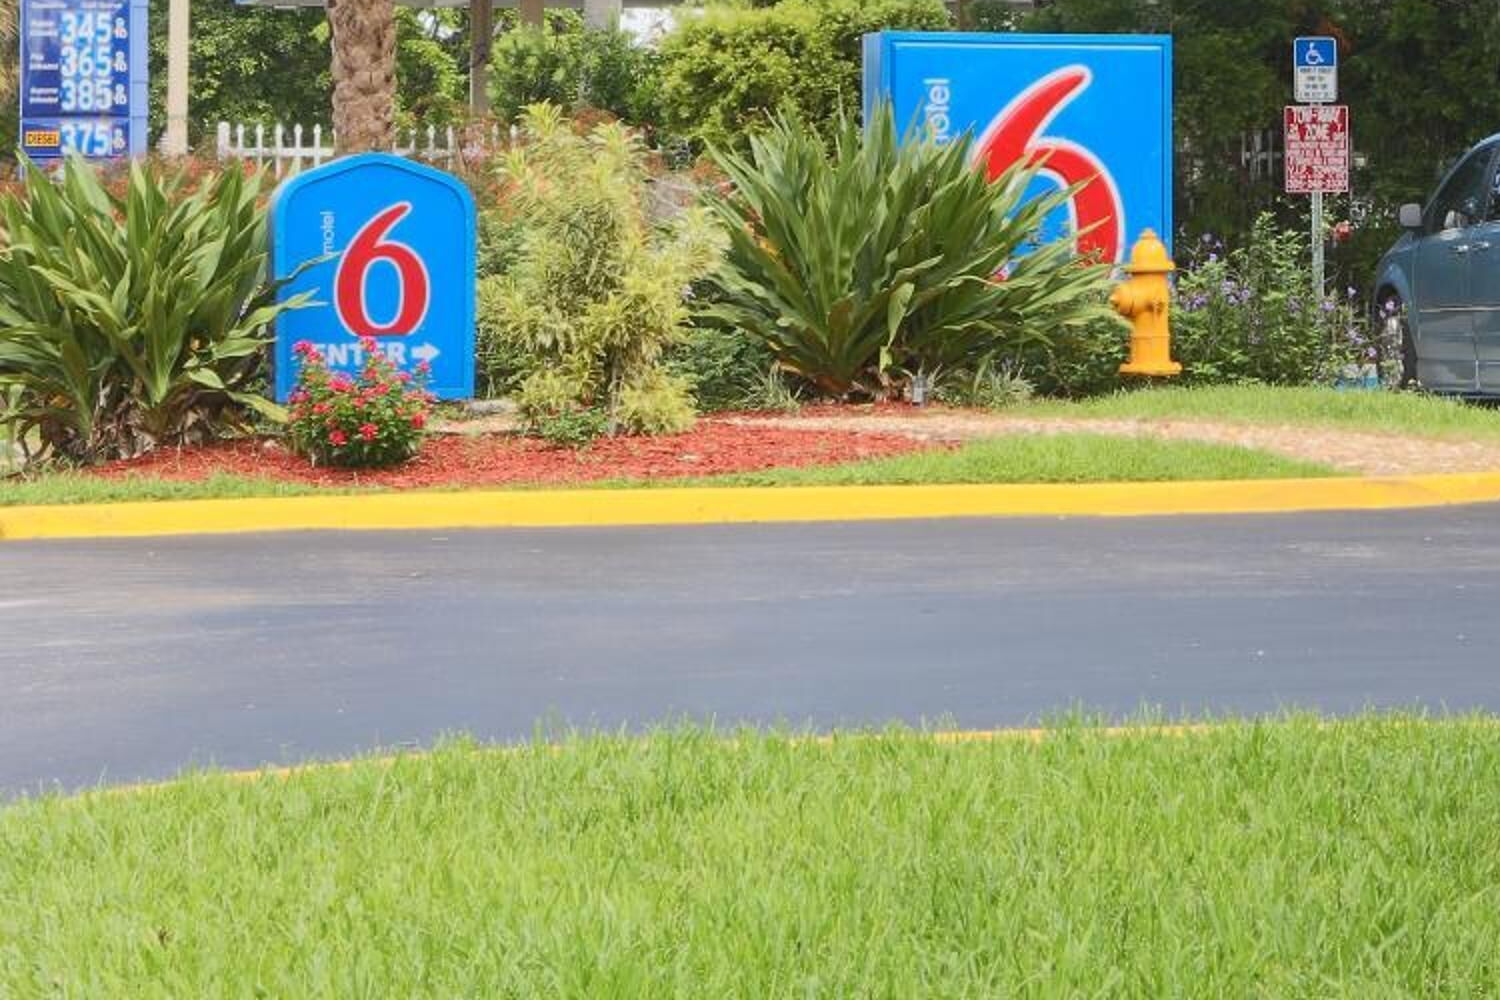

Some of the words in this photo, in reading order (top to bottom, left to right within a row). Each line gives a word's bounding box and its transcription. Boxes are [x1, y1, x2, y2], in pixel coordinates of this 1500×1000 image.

[61, 12, 112, 42] 345
[61, 46, 112, 77] 365
[61, 80, 112, 110] 385
[923, 77, 950, 145] otel
[61, 121, 112, 155] 375
[333, 201, 431, 338] 6
